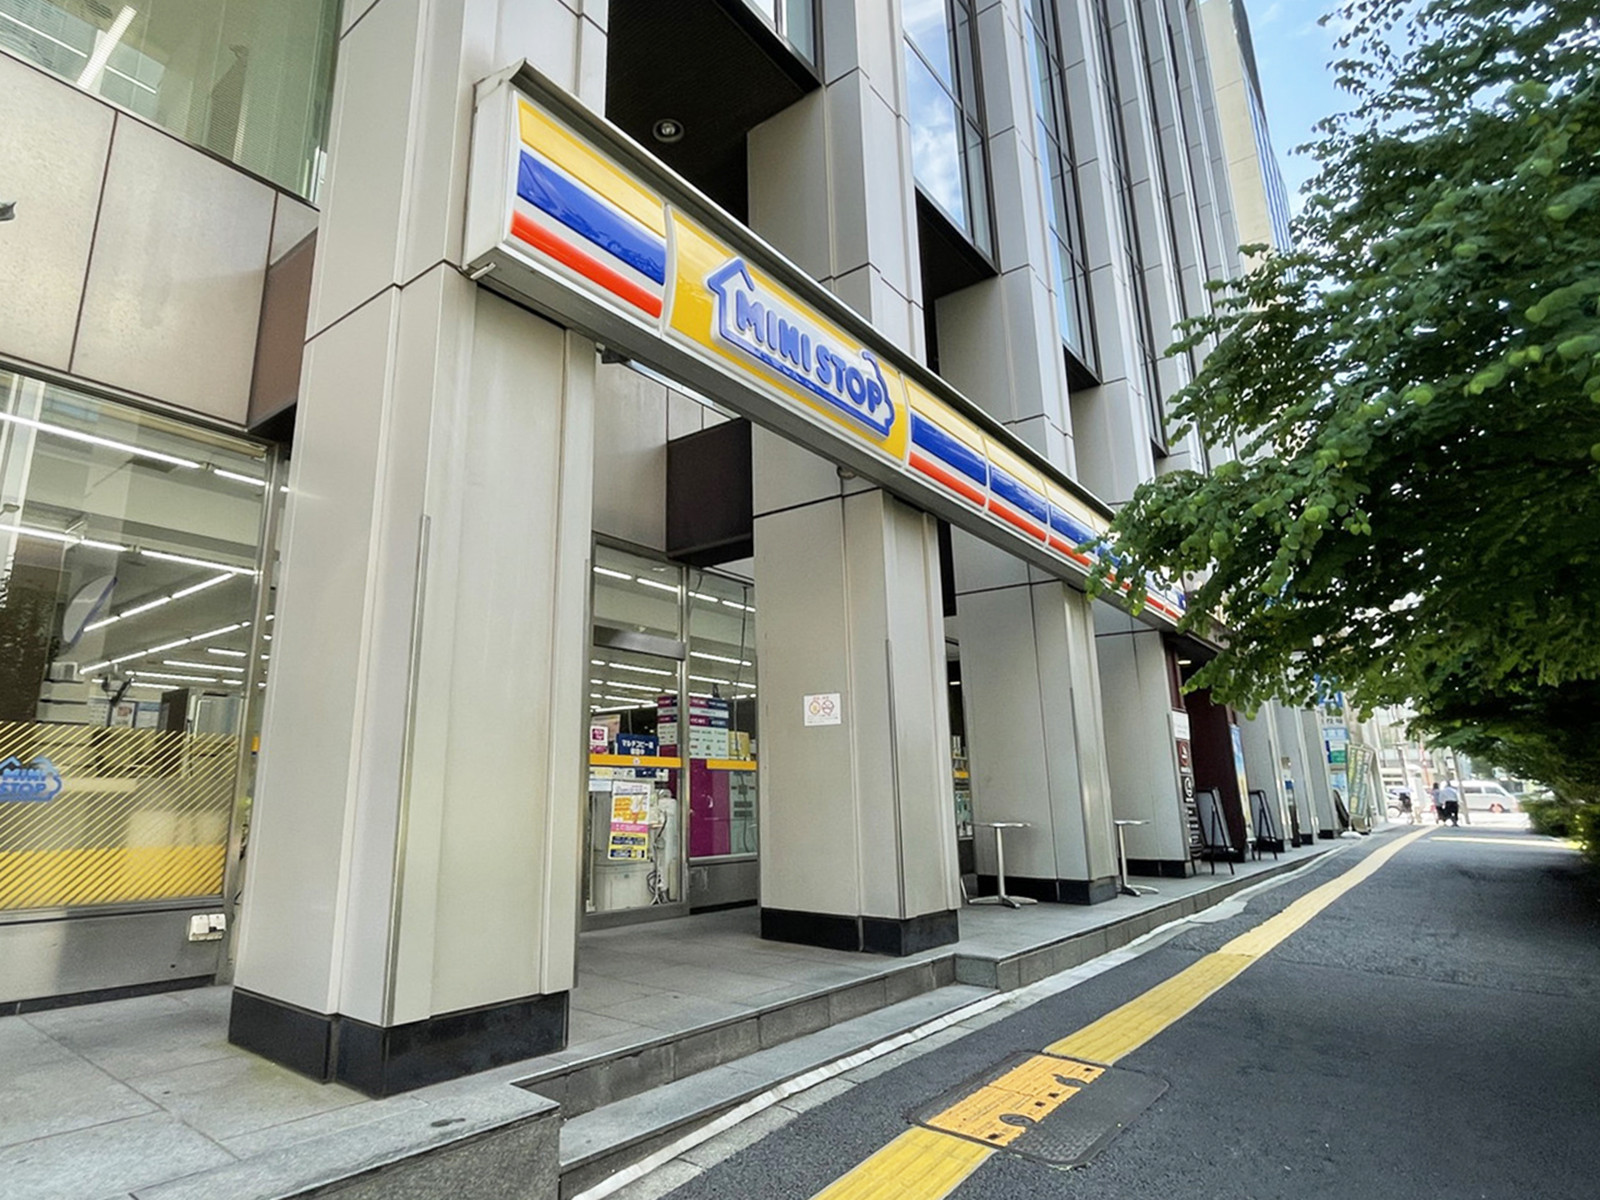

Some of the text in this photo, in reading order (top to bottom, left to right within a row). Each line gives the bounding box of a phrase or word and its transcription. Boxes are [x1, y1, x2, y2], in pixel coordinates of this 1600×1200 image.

[736, 290, 883, 413] MINI STOP
[3, 768, 46, 781] MINI
[0, 782, 46, 795] STOP
